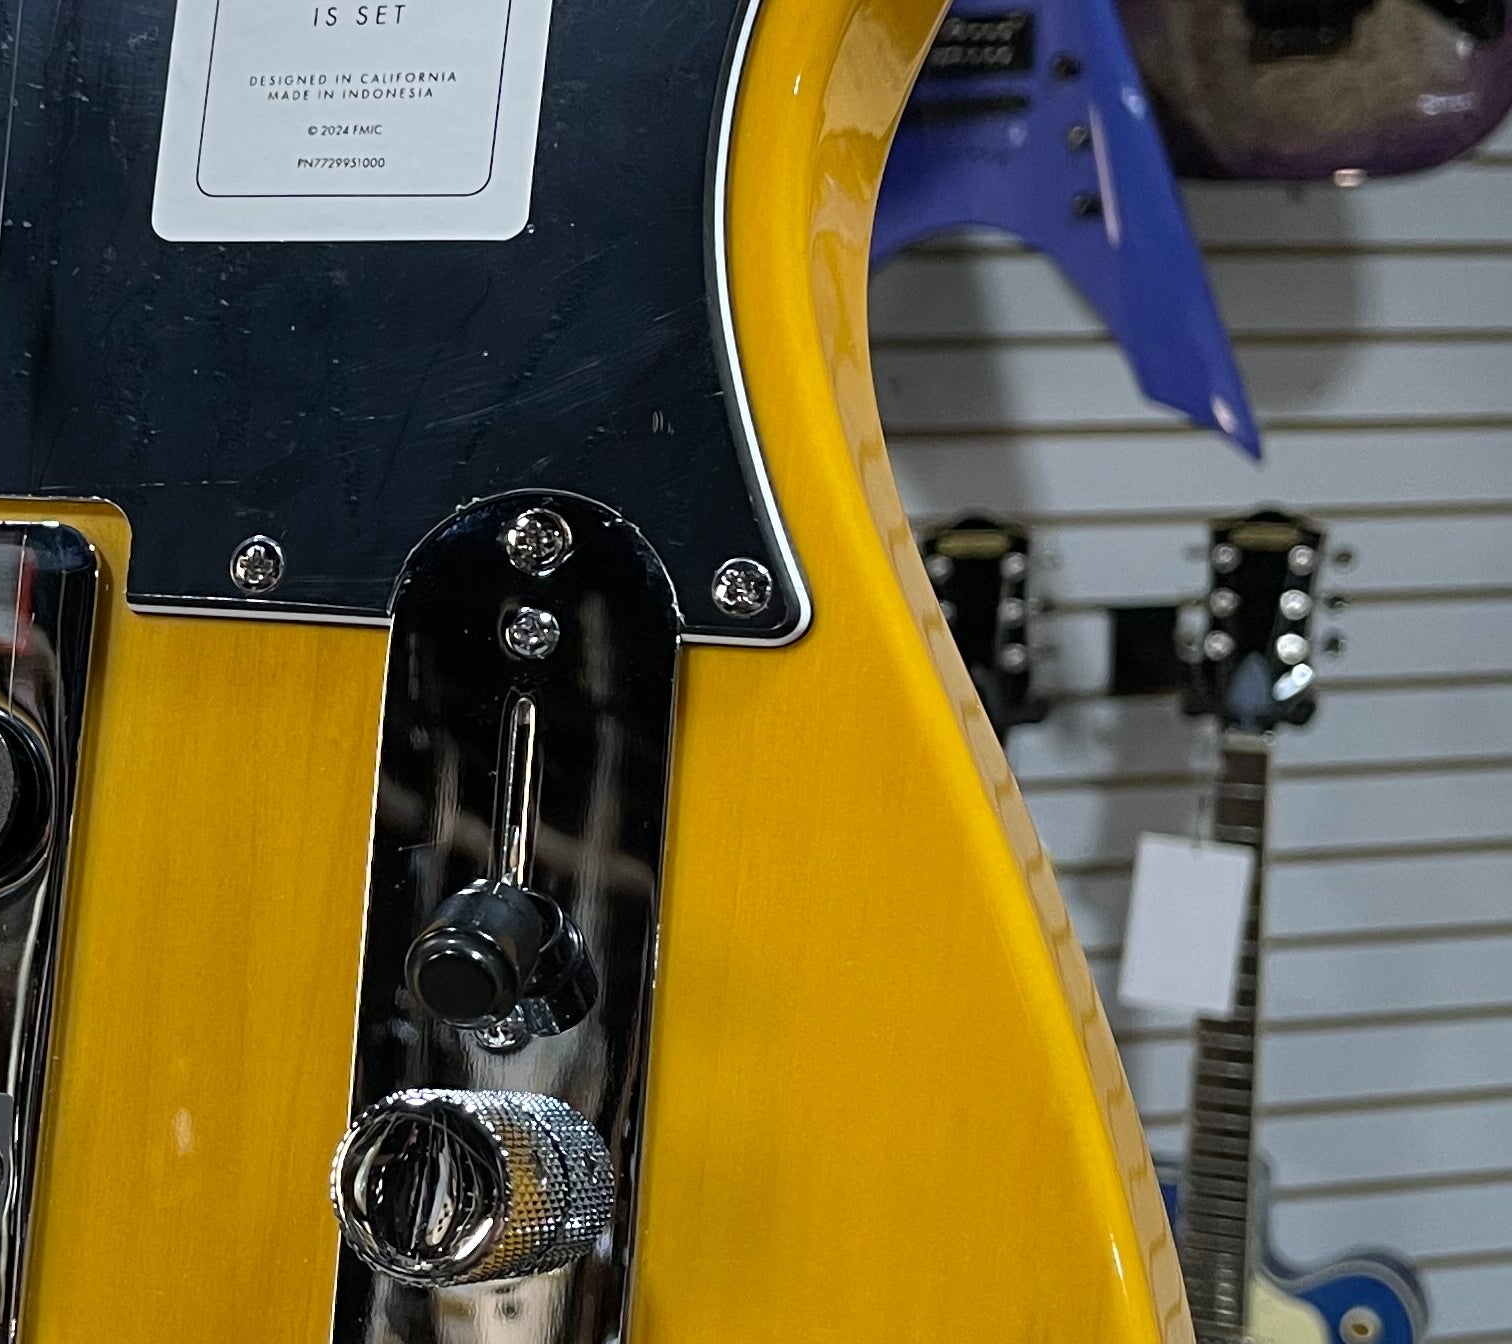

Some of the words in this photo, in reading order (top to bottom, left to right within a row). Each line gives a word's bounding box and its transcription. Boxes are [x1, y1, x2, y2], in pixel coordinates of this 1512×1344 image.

[313, 6, 337, 27] IS
[356, 4, 406, 26] SET
[249, 74, 327, 86] DESIGNED
[335, 74, 352, 84] IN
[360, 71, 457, 84] CALIFORNIA
[267, 90, 309, 101] MADE
[318, 89, 334, 99] IN
[342, 87, 433, 99] INDONESIA
[320, 125, 349, 136] 2024
[352, 124, 383, 135] FMIC
